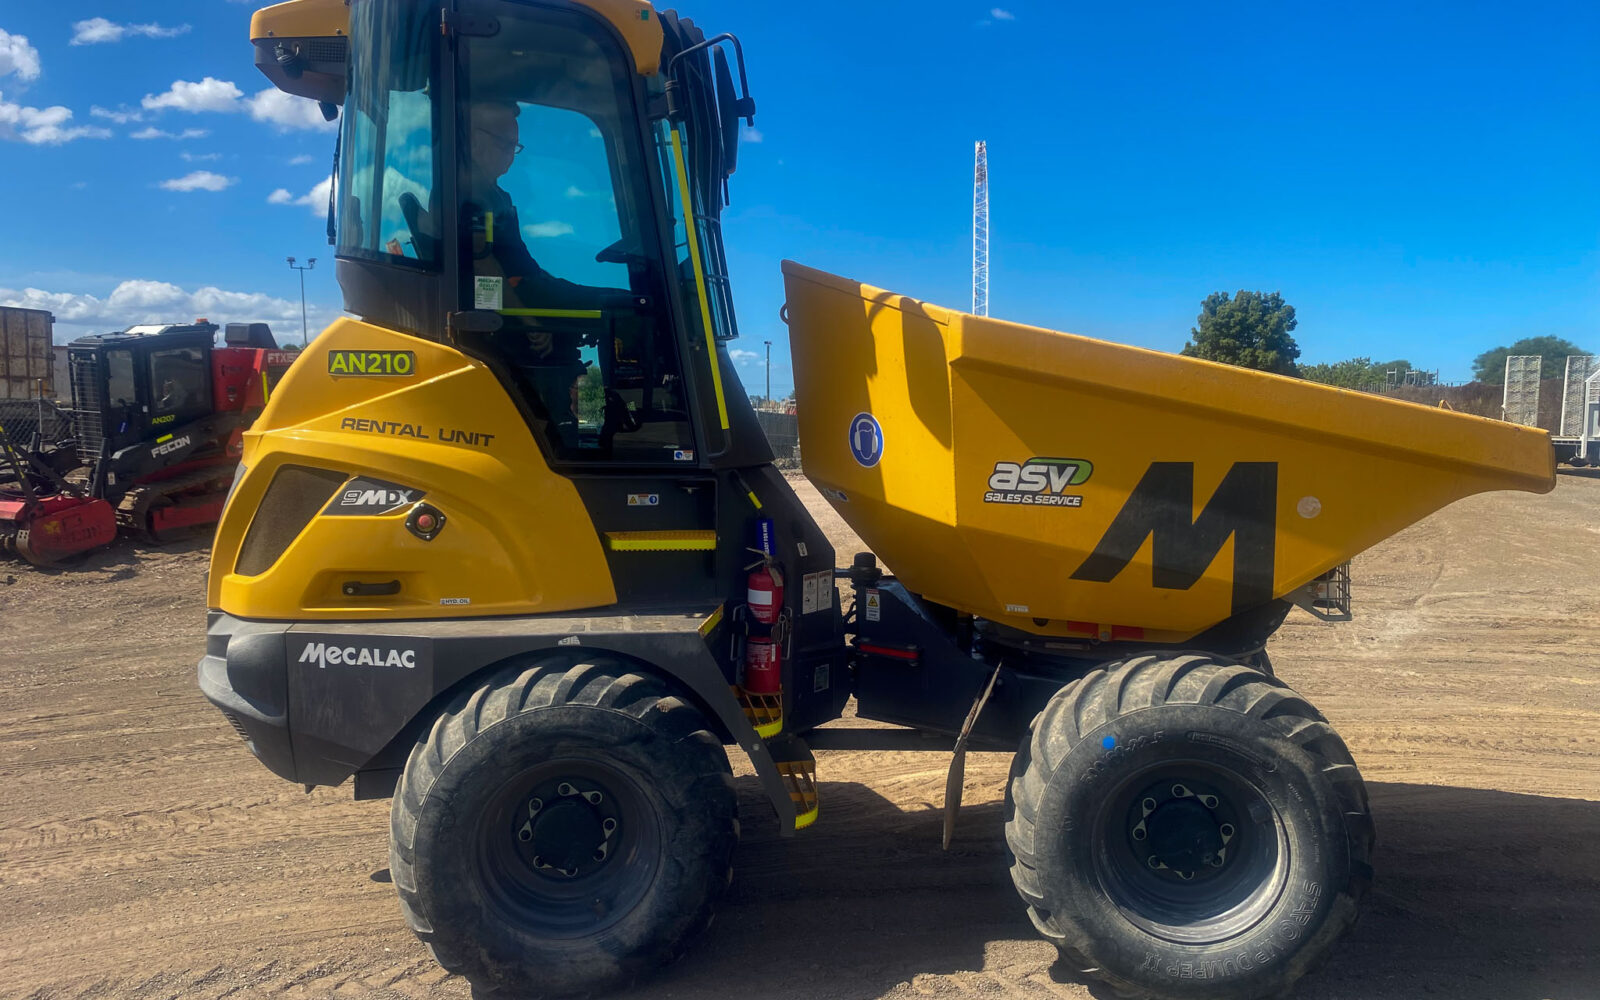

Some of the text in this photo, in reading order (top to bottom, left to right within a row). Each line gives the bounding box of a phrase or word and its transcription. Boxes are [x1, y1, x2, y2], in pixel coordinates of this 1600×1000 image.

[329, 353, 411, 374] AN210
[341, 417, 495, 447] RENTAL UNIT
[151, 435, 191, 458] FECON
[1022, 494, 1034, 504] &
[1035, 495, 1081, 506] SERVICE
